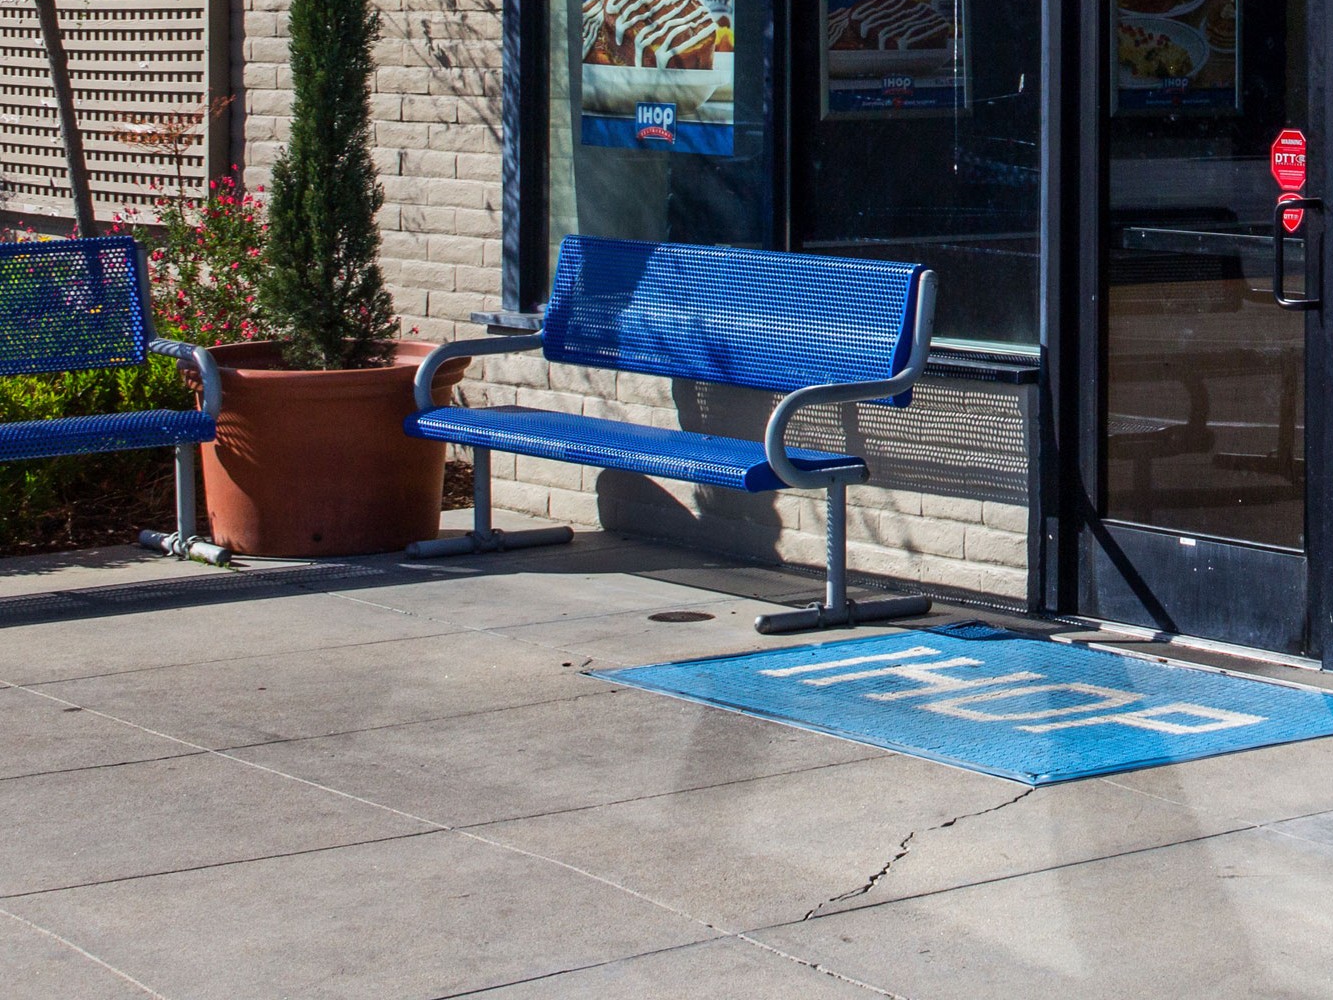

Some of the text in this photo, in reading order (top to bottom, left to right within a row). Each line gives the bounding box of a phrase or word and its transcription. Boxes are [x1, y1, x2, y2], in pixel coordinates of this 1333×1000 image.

[883, 77, 911, 89] IHOP
[1164, 78, 1188, 88] IHOP
[638, 106, 673, 131] IHOP
[1275, 153, 1296, 163] DTT
[757, 645, 1269, 737] IHOP
